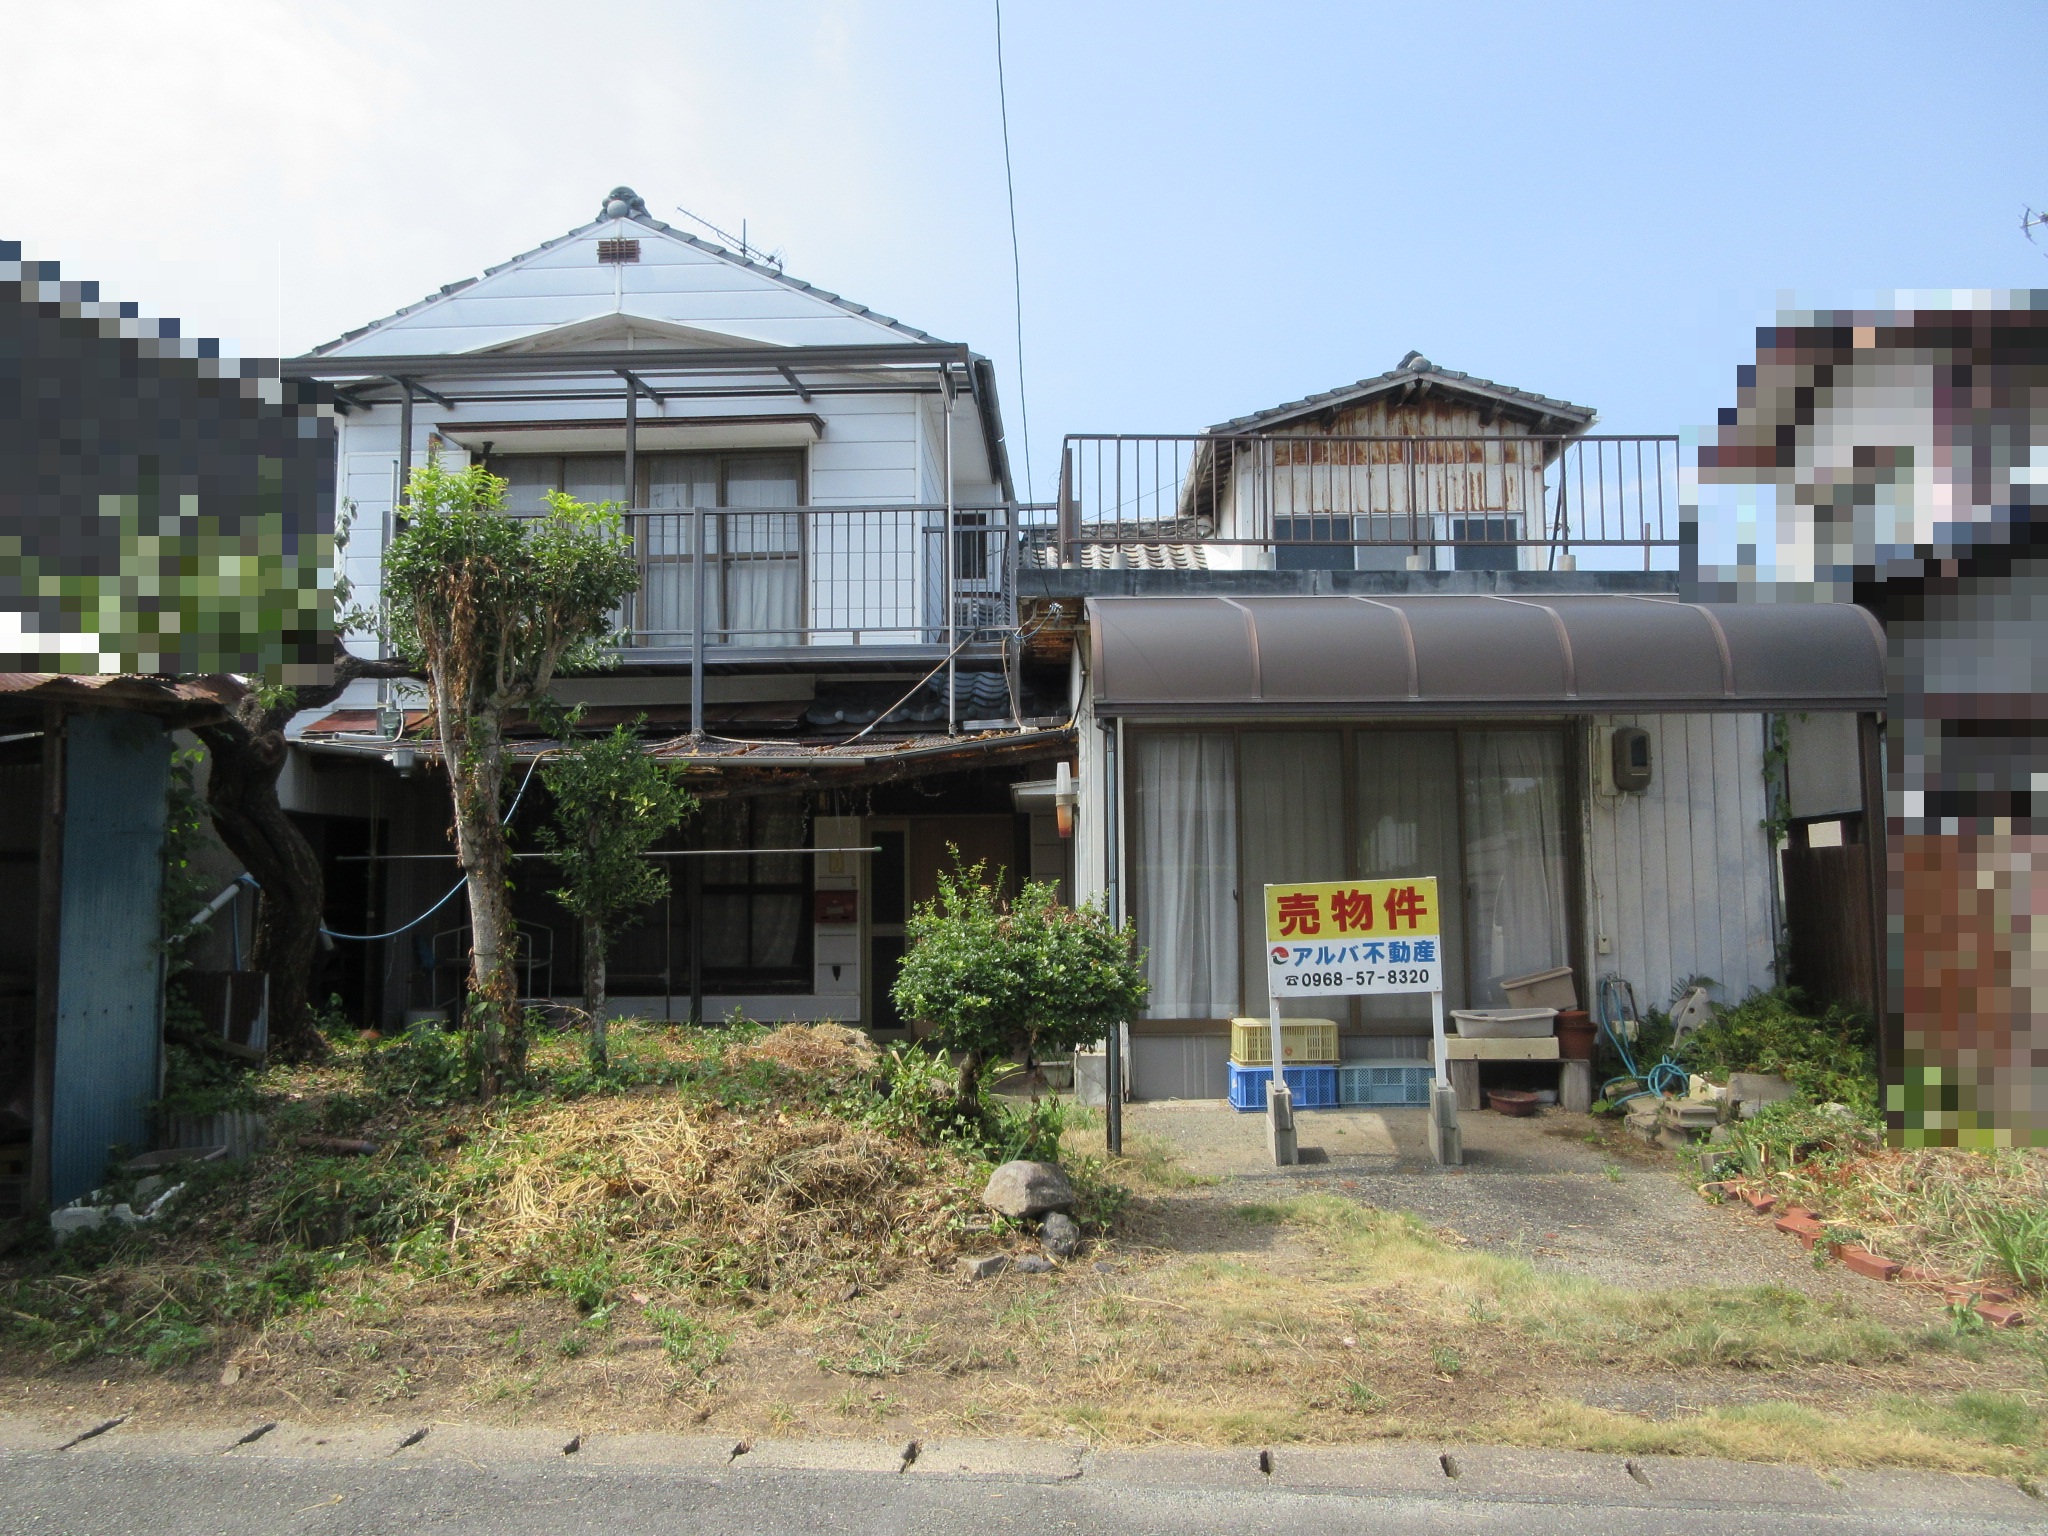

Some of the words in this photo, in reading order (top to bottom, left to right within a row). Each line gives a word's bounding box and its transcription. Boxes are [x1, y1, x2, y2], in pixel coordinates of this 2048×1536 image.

[1277, 886, 1427, 936] 売物件
[1293, 940, 1435, 967] アルバ不動産
[1302, 969, 1429, 986] 0968-57-8320
